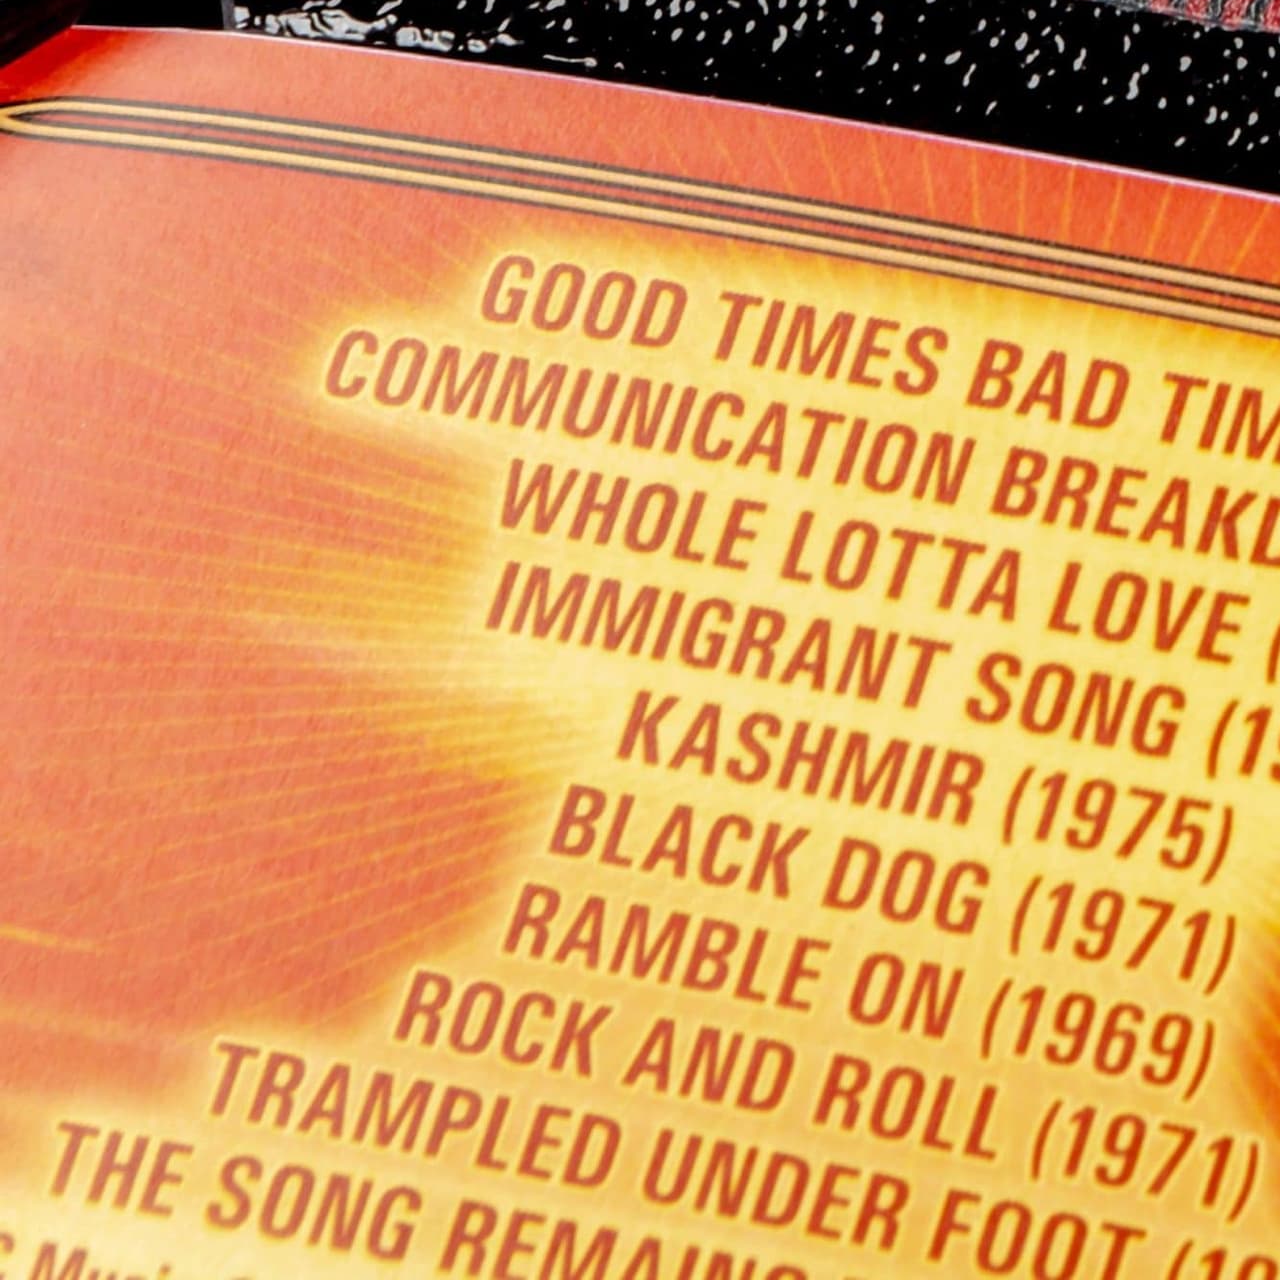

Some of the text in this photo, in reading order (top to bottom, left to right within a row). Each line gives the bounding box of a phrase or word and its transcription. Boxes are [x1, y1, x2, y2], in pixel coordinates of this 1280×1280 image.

[326, 330, 977, 505] COMMUNICATION
[481, 255, 688, 348] GOOD
[715, 291, 949, 396] TIMES
[966, 339, 1130, 429] BAD
[486, 561, 953, 708] IMMIGRANT
[965, 652, 1186, 758] SONG
[501, 458, 767, 571] WHOLE
[781, 510, 1021, 621] LOTTA
[1048, 562, 1251, 665] LOVE
[617, 690, 1233, 885] KASHMIR (1975)
[549, 784, 1236, 995] BLACK DOG (1971)
[504, 883, 1215, 1100] RAMBLE ON (1969)
[52, 1122, 194, 1217] THE
[207, 1155, 422, 1261] SONG
[211, 1042, 1147, 1280] TRAMPLED UNDER FOOT
[395, 970, 1259, 1221] ROCK AND ROLL (1971)
